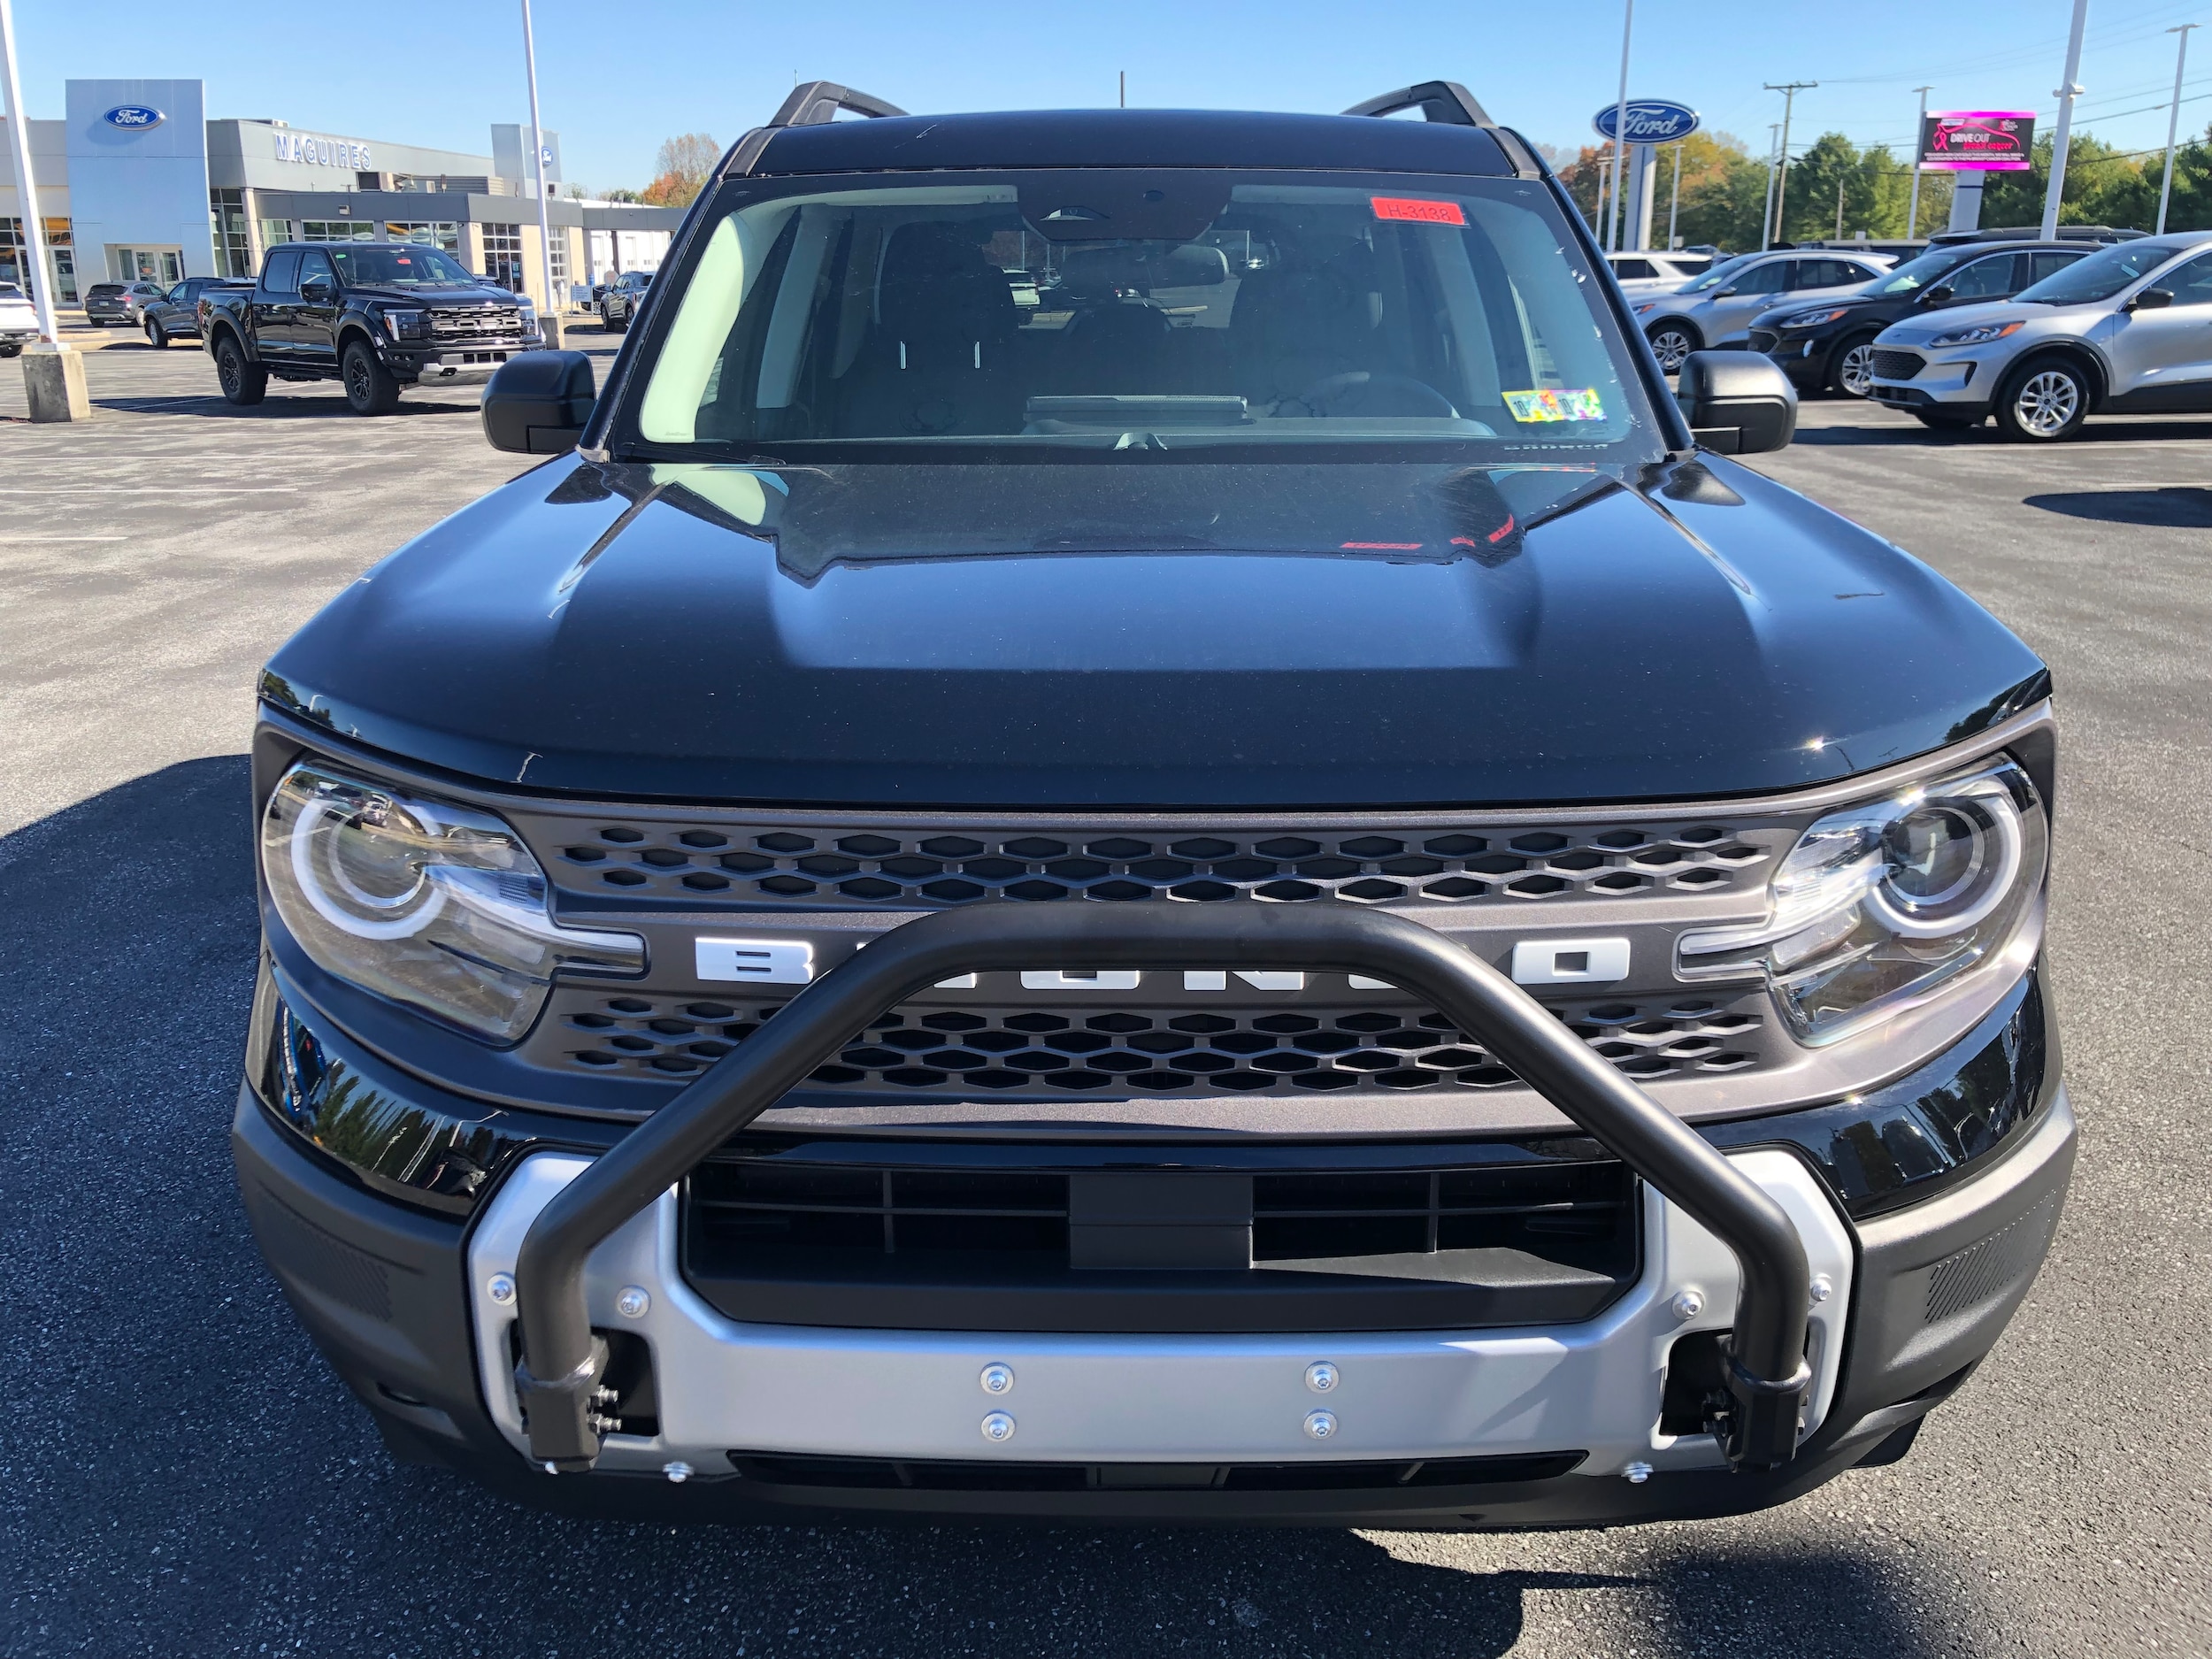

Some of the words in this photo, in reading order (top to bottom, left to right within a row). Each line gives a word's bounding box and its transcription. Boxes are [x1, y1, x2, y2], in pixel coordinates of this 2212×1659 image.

[115, 109, 149, 124] Ford
[1623, 108, 1681, 135] Ford
[1974, 133, 1991, 143] OUT
[274, 133, 372, 170] MAGUIRES
[1386, 204, 1452, 222] H-3138
[431, 319, 522, 331] FORD
